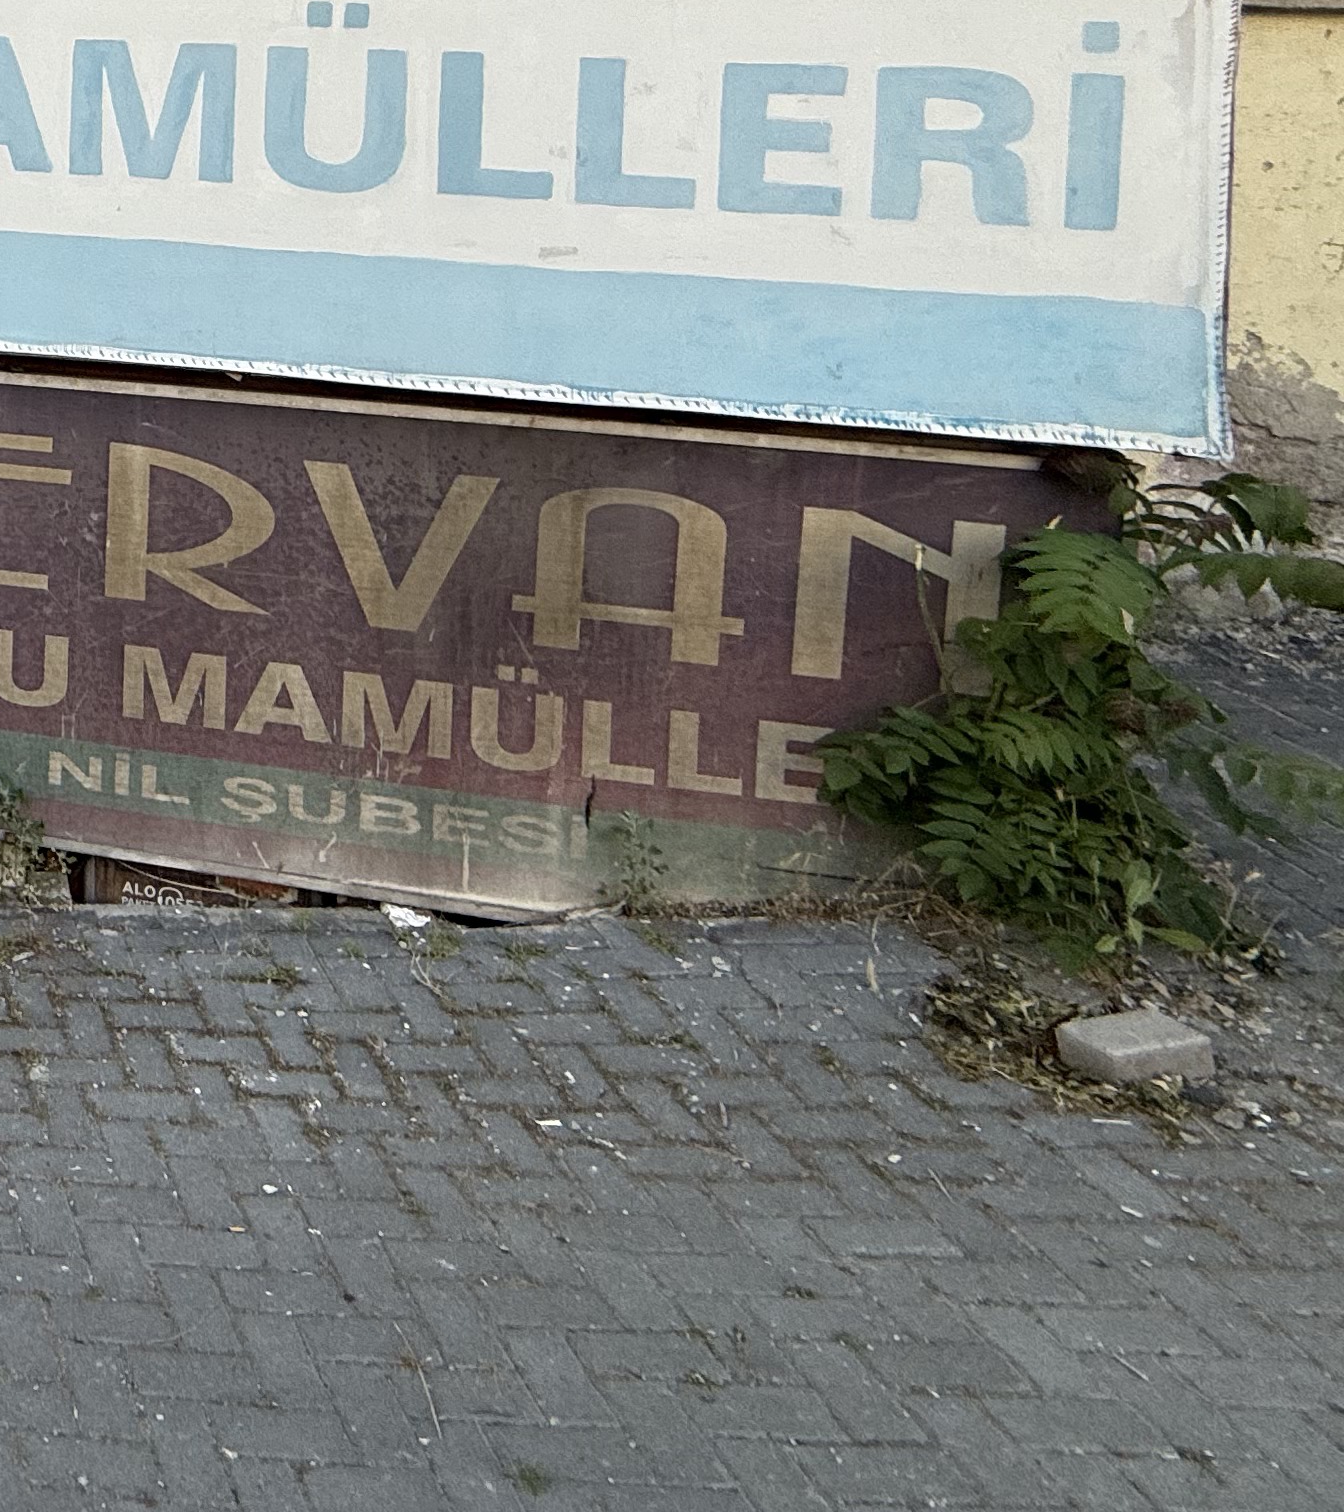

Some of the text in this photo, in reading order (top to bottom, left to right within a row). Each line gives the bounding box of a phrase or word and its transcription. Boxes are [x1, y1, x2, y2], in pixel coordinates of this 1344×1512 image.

[122, 644, 835, 805] MAMÜLLE
[47, 750, 589, 858] NİL ŞUBESİ
[122, 881, 156, 898] ALO
